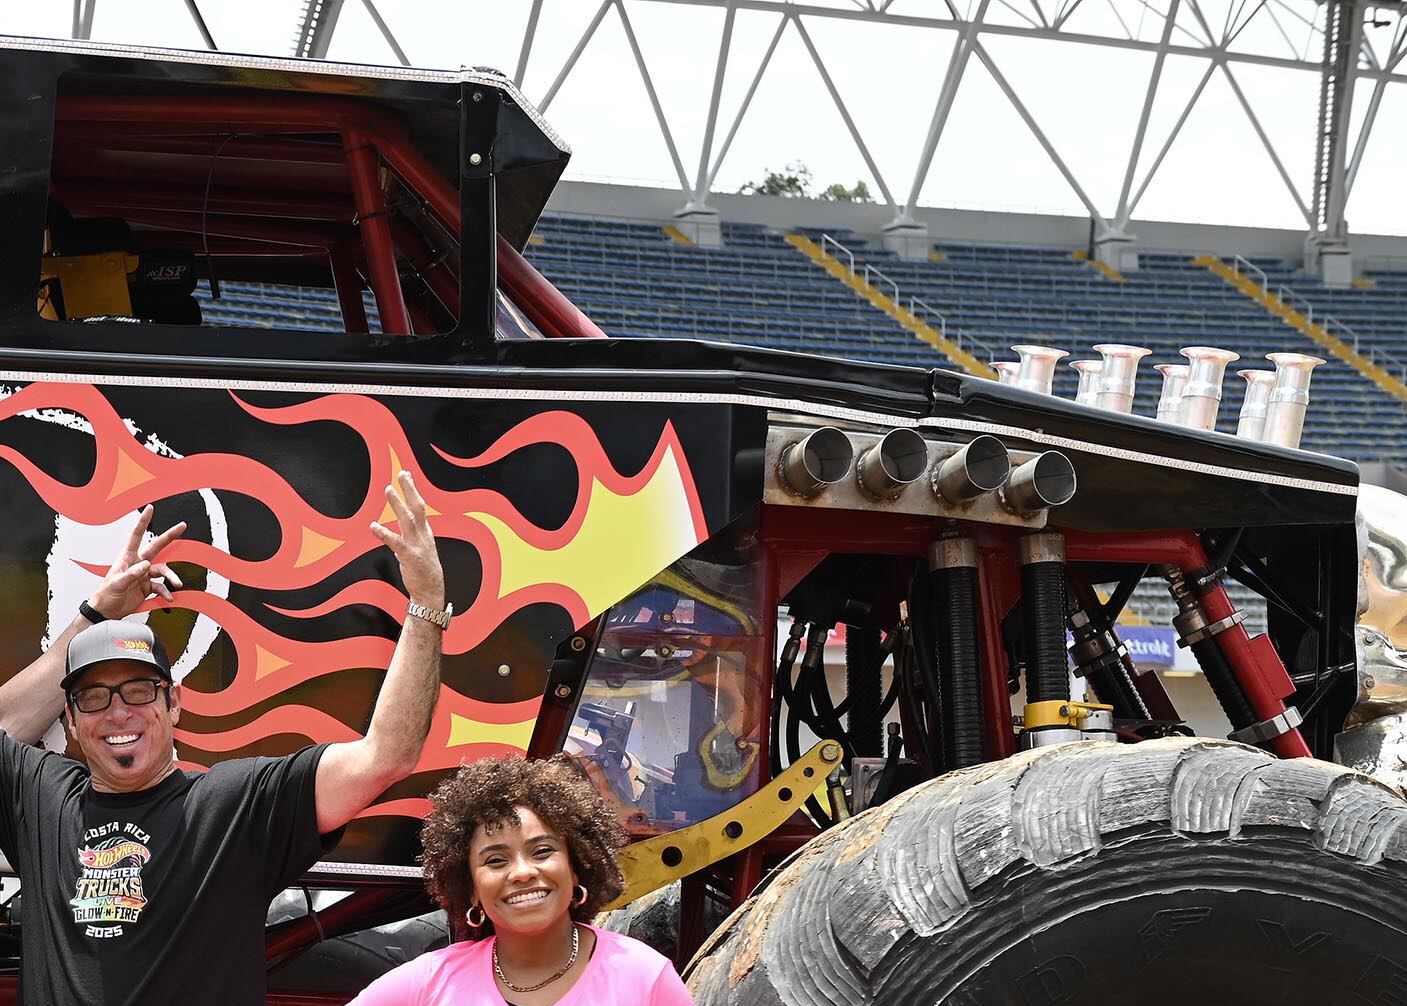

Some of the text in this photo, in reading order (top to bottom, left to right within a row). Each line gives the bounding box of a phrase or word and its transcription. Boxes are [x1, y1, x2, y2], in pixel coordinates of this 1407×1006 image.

[84, 821, 151, 844] COSTA RICA
[82, 867, 141, 879] MONSTER
[77, 877, 143, 900] TRUCKS
[85, 924, 124, 938] 2025
